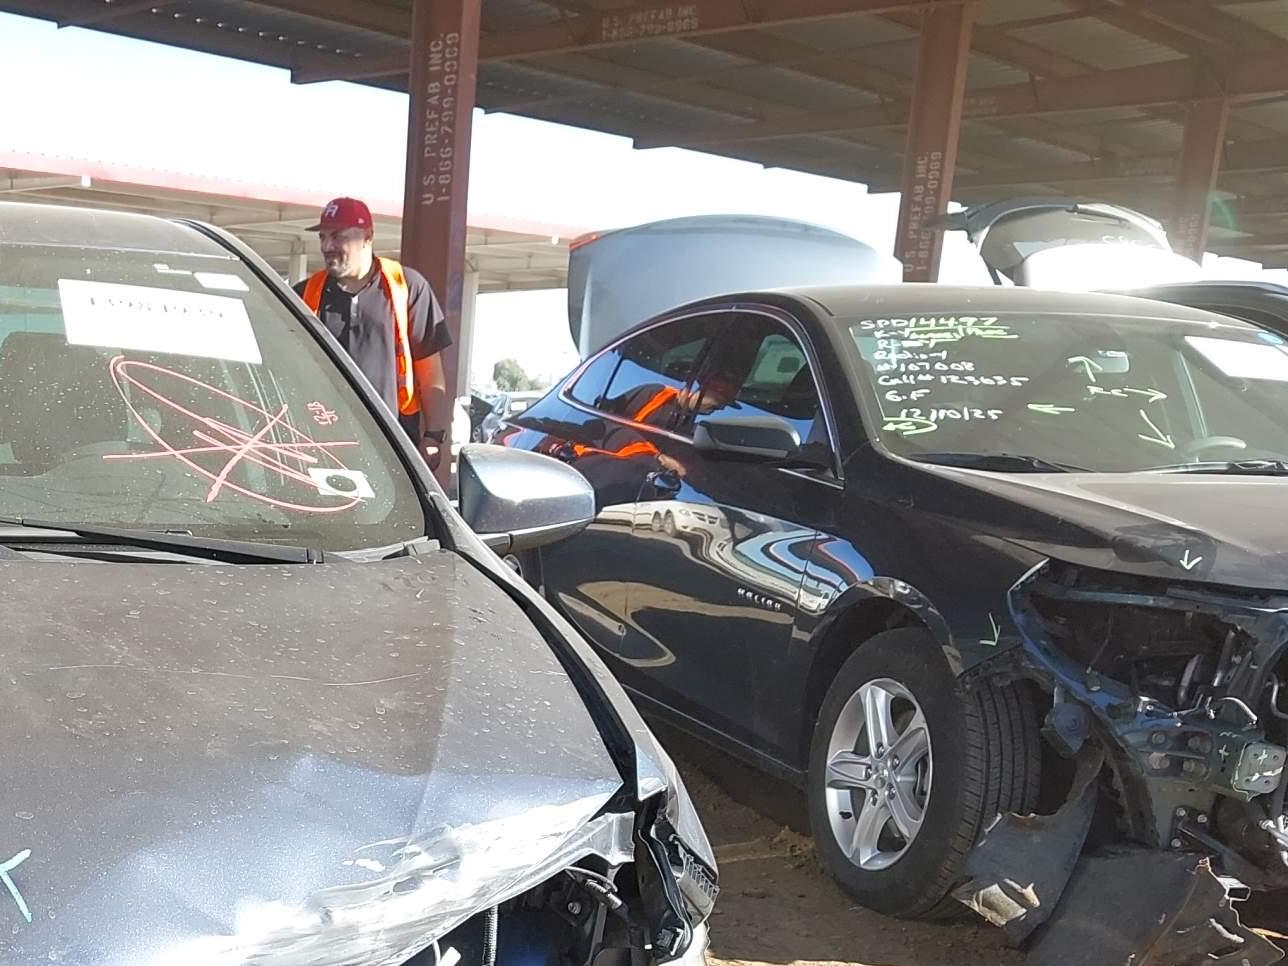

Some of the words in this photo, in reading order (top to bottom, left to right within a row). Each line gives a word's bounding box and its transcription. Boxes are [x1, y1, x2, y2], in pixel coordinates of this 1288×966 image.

[428, 32, 445, 72] INC.
[423, 81, 441, 158] PREFAB
[908, 184, 925, 240] PREFAB
